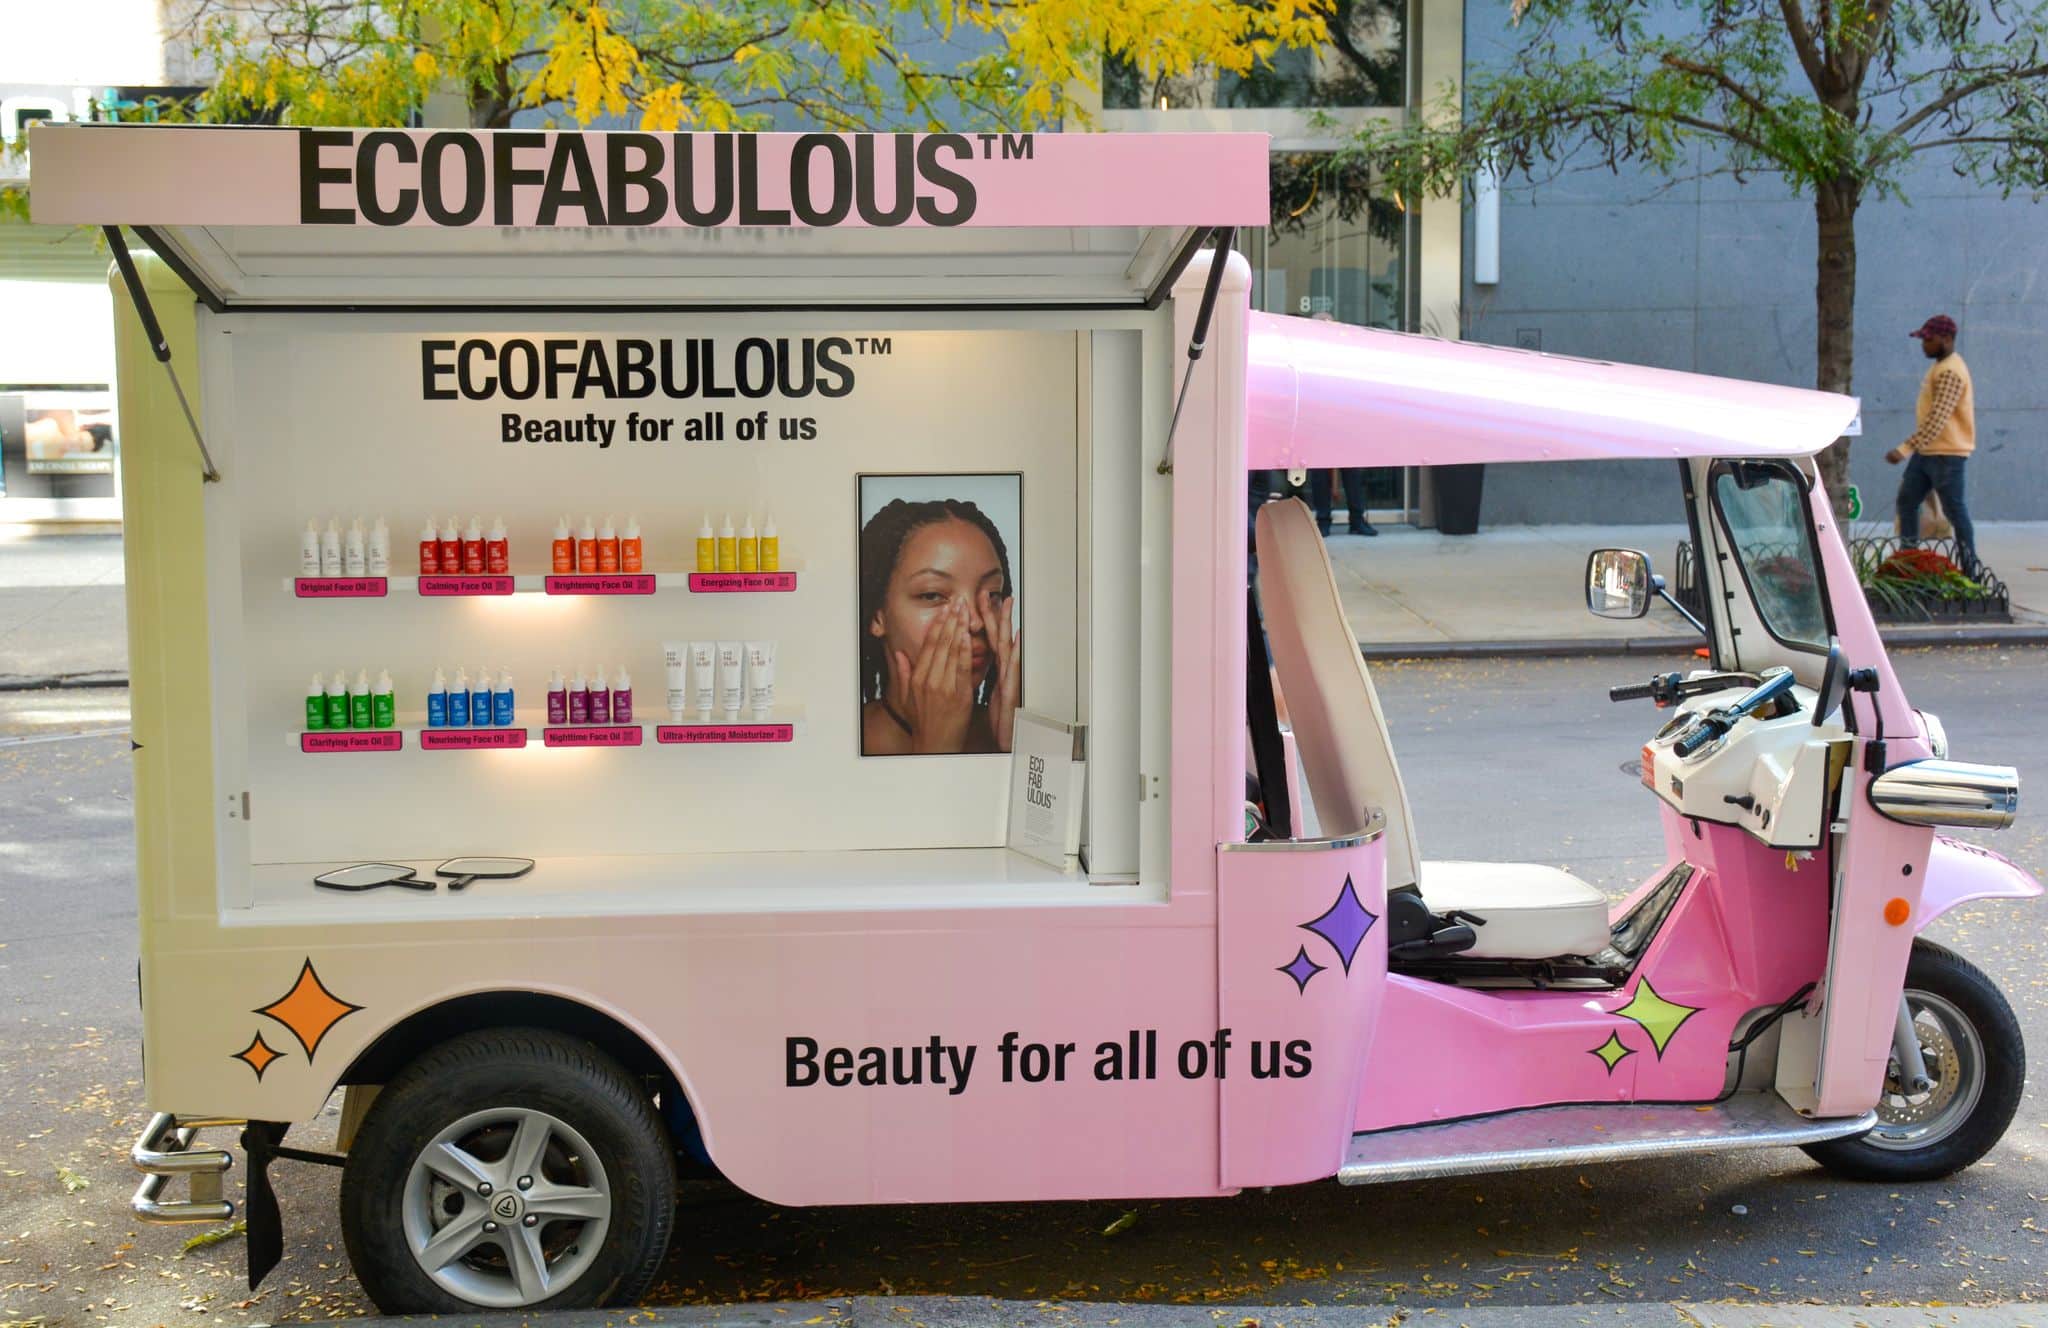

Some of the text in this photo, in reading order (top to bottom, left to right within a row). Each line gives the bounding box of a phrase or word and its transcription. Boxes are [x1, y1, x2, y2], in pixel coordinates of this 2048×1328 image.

[299, 131, 1033, 226] ECOFABULOUS™
[421, 337, 892, 400] ECOFABULOUS™
[502, 410, 817, 448] Beauty for all of us
[300, 582, 367, 593] Original Face Oil
[426, 581, 493, 592] Calming Face Oil
[554, 580, 633, 591] Brightening Face Oil
[700, 577, 775, 588] Energizing Face Oil
[428, 734, 505, 745] Nourishing Face Oil
[549, 731, 621, 743] Nighttime Face Oil
[663, 731, 775, 742] Ultra-Hydrating Moisturizer
[309, 737, 382, 748] Clarifying Face Oil
[1029, 755, 1045, 773] ECO
[1028, 771, 1043, 789] FAB
[785, 1028, 1312, 1095] Beauty for all of us
